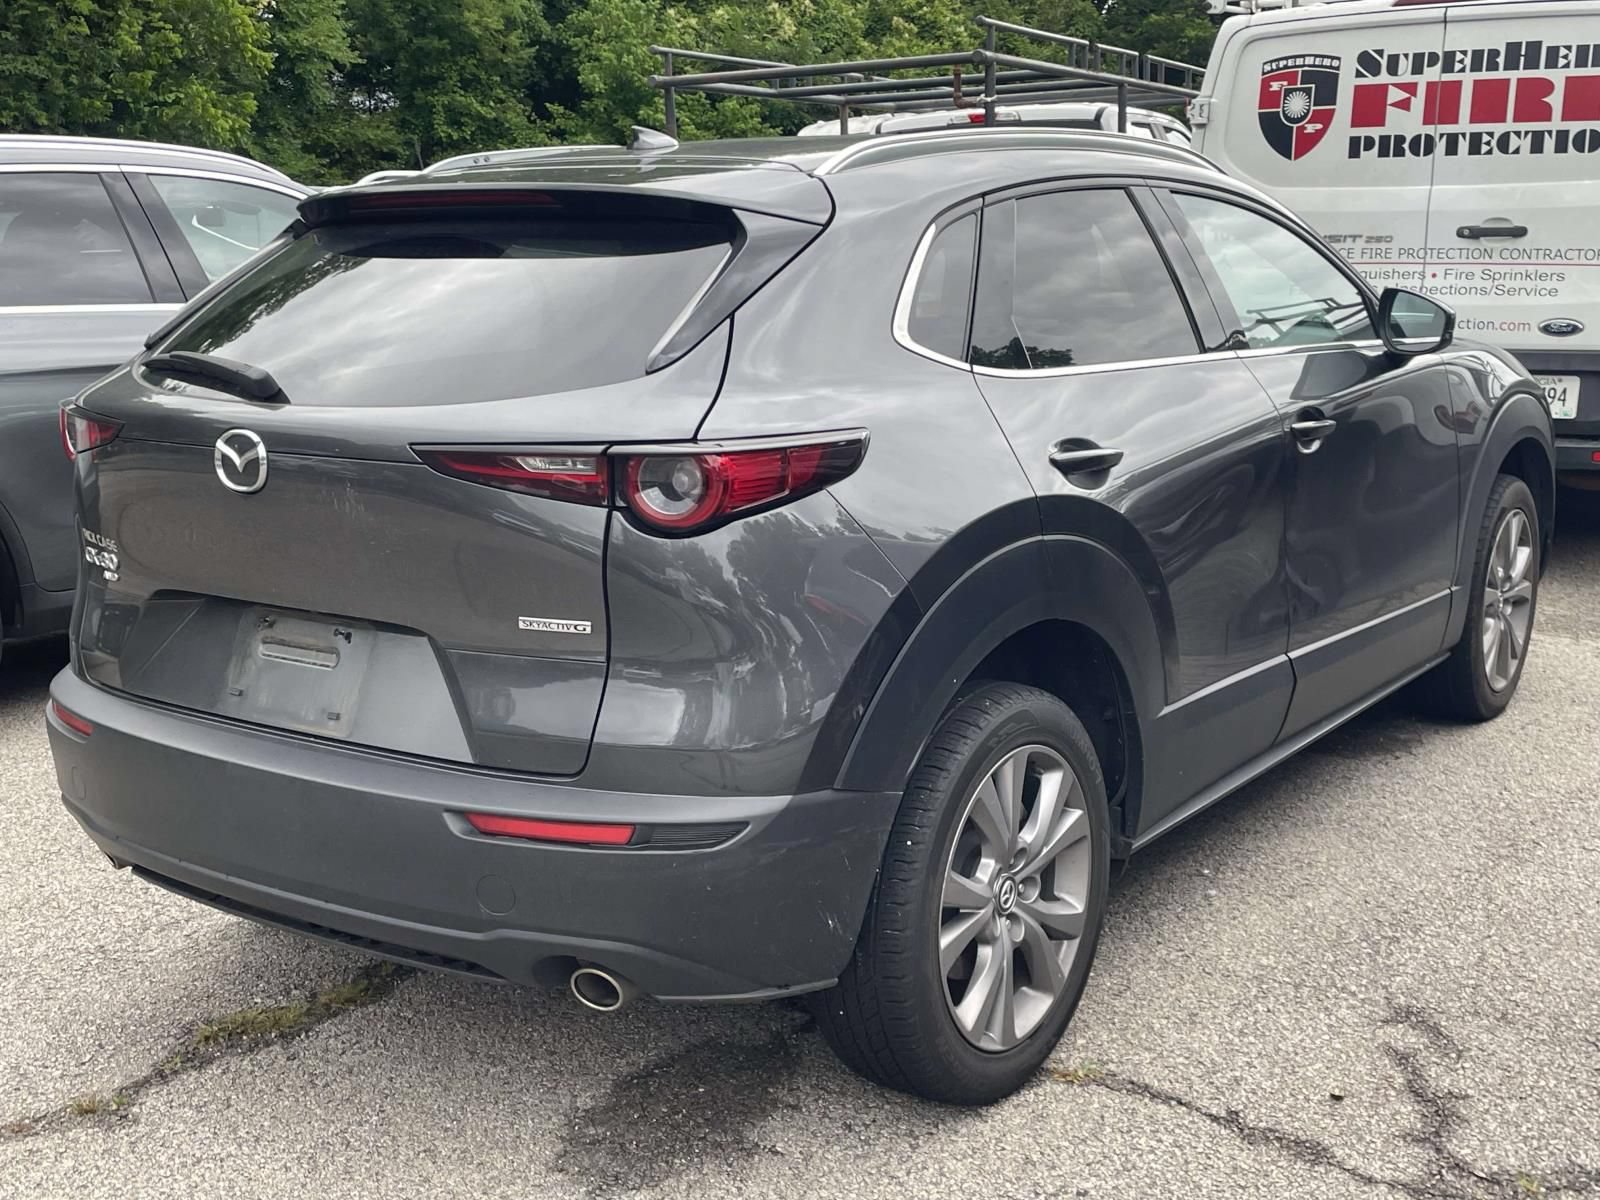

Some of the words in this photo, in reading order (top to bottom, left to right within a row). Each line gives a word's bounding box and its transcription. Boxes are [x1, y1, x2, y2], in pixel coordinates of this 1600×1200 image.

[1361, 247, 1392, 260] FIRE
[1398, 247, 1494, 260] PROTECTION
[1443, 268, 1475, 281] Fire
[1480, 268, 1566, 283] Sprinklers
[1542, 387, 1567, 407] 94
